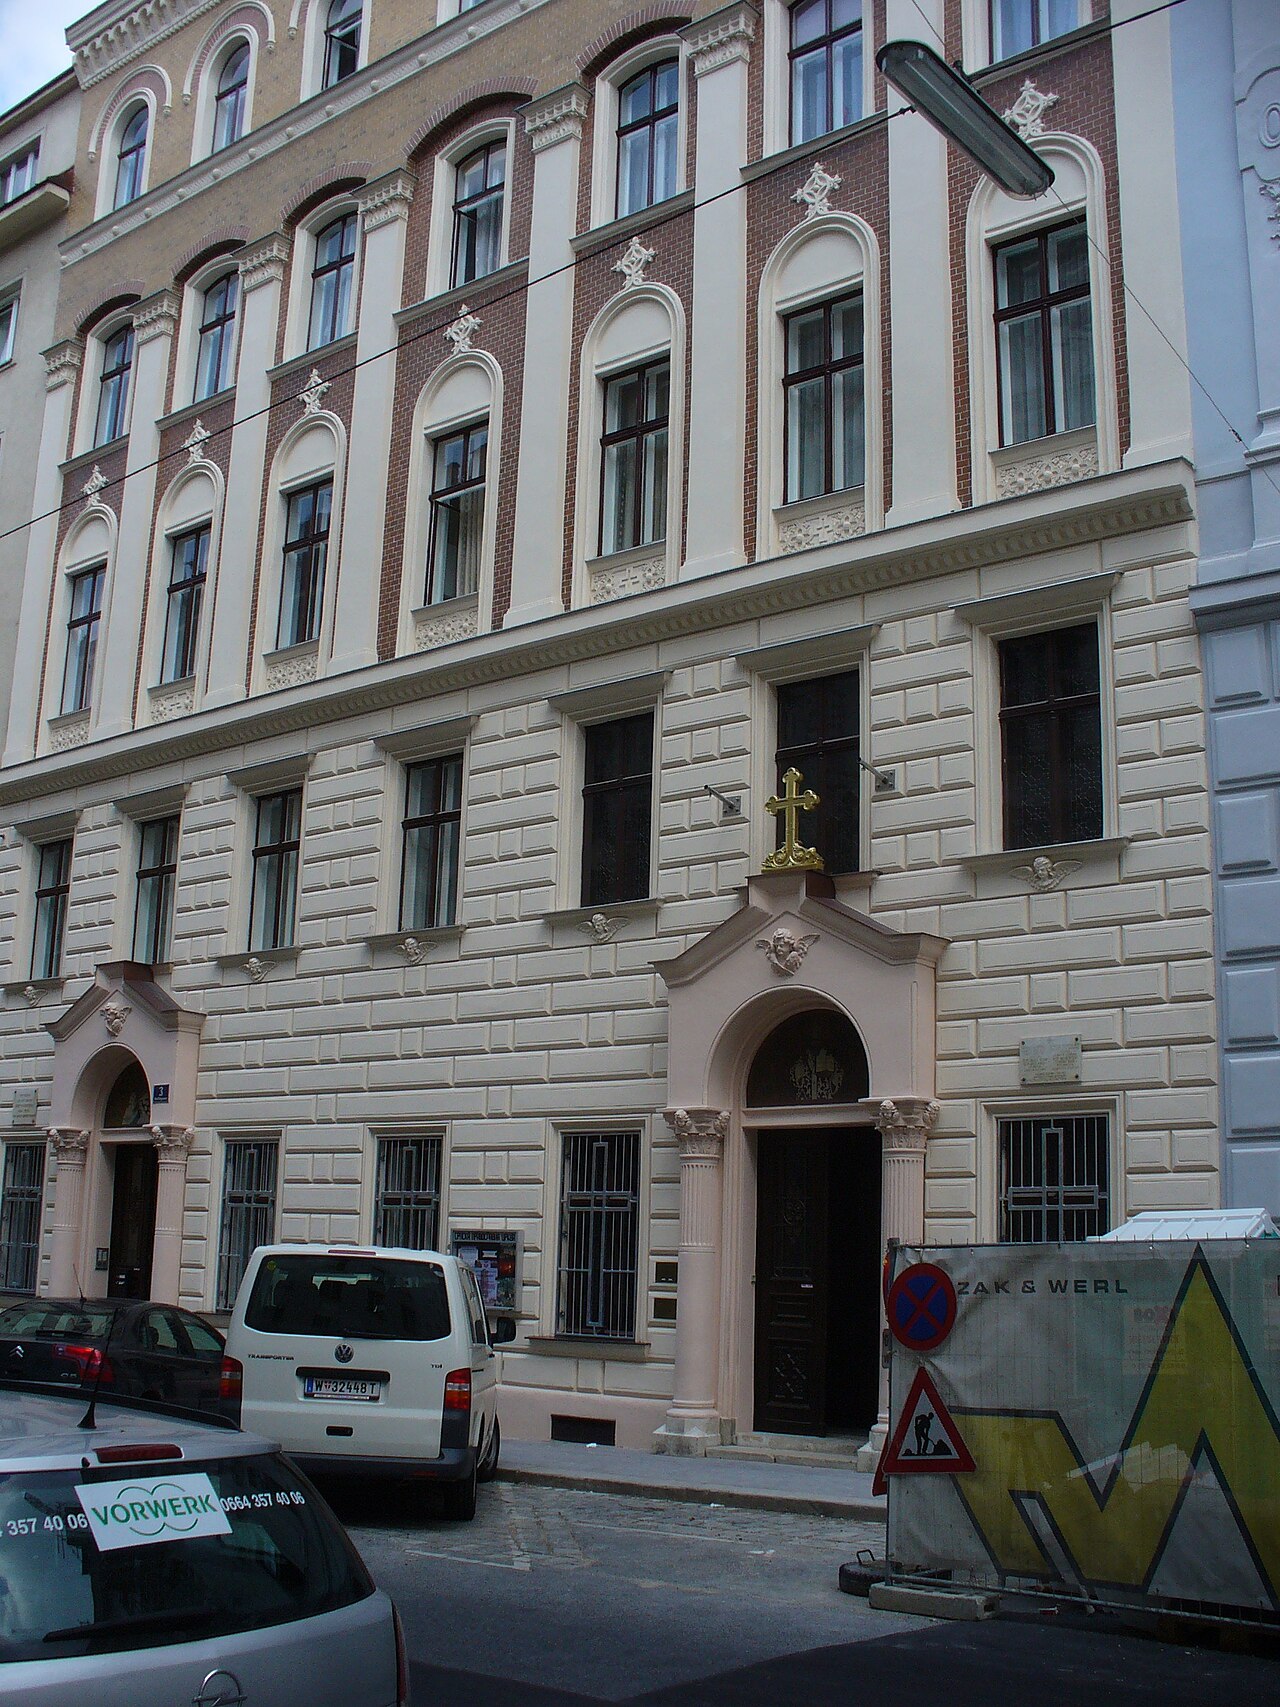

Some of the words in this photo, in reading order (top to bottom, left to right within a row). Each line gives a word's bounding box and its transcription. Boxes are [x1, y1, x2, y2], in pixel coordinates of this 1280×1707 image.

[158, 1086, 164, 1097] 3
[957, 1281, 1010, 1295] ZAK
[1021, 1280, 1036, 1294] &
[1048, 1279, 1128, 1294] WERL
[315, 1379, 323, 1391] W
[331, 1380, 367, 1394] 32448
[370, 1382, 377, 1394] T
[91, 1494, 217, 1526] VORWERK
[221, 1497, 252, 1512] 0664
[252, 1493, 273, 1508] 357
[276, 1492, 291, 1505] 40
[291, 1491, 305, 1505] 06
[7, 1517, 36, 1537] 357
[43, 1515, 63, 1531] 40
[67, 1513, 88, 1529] 06
